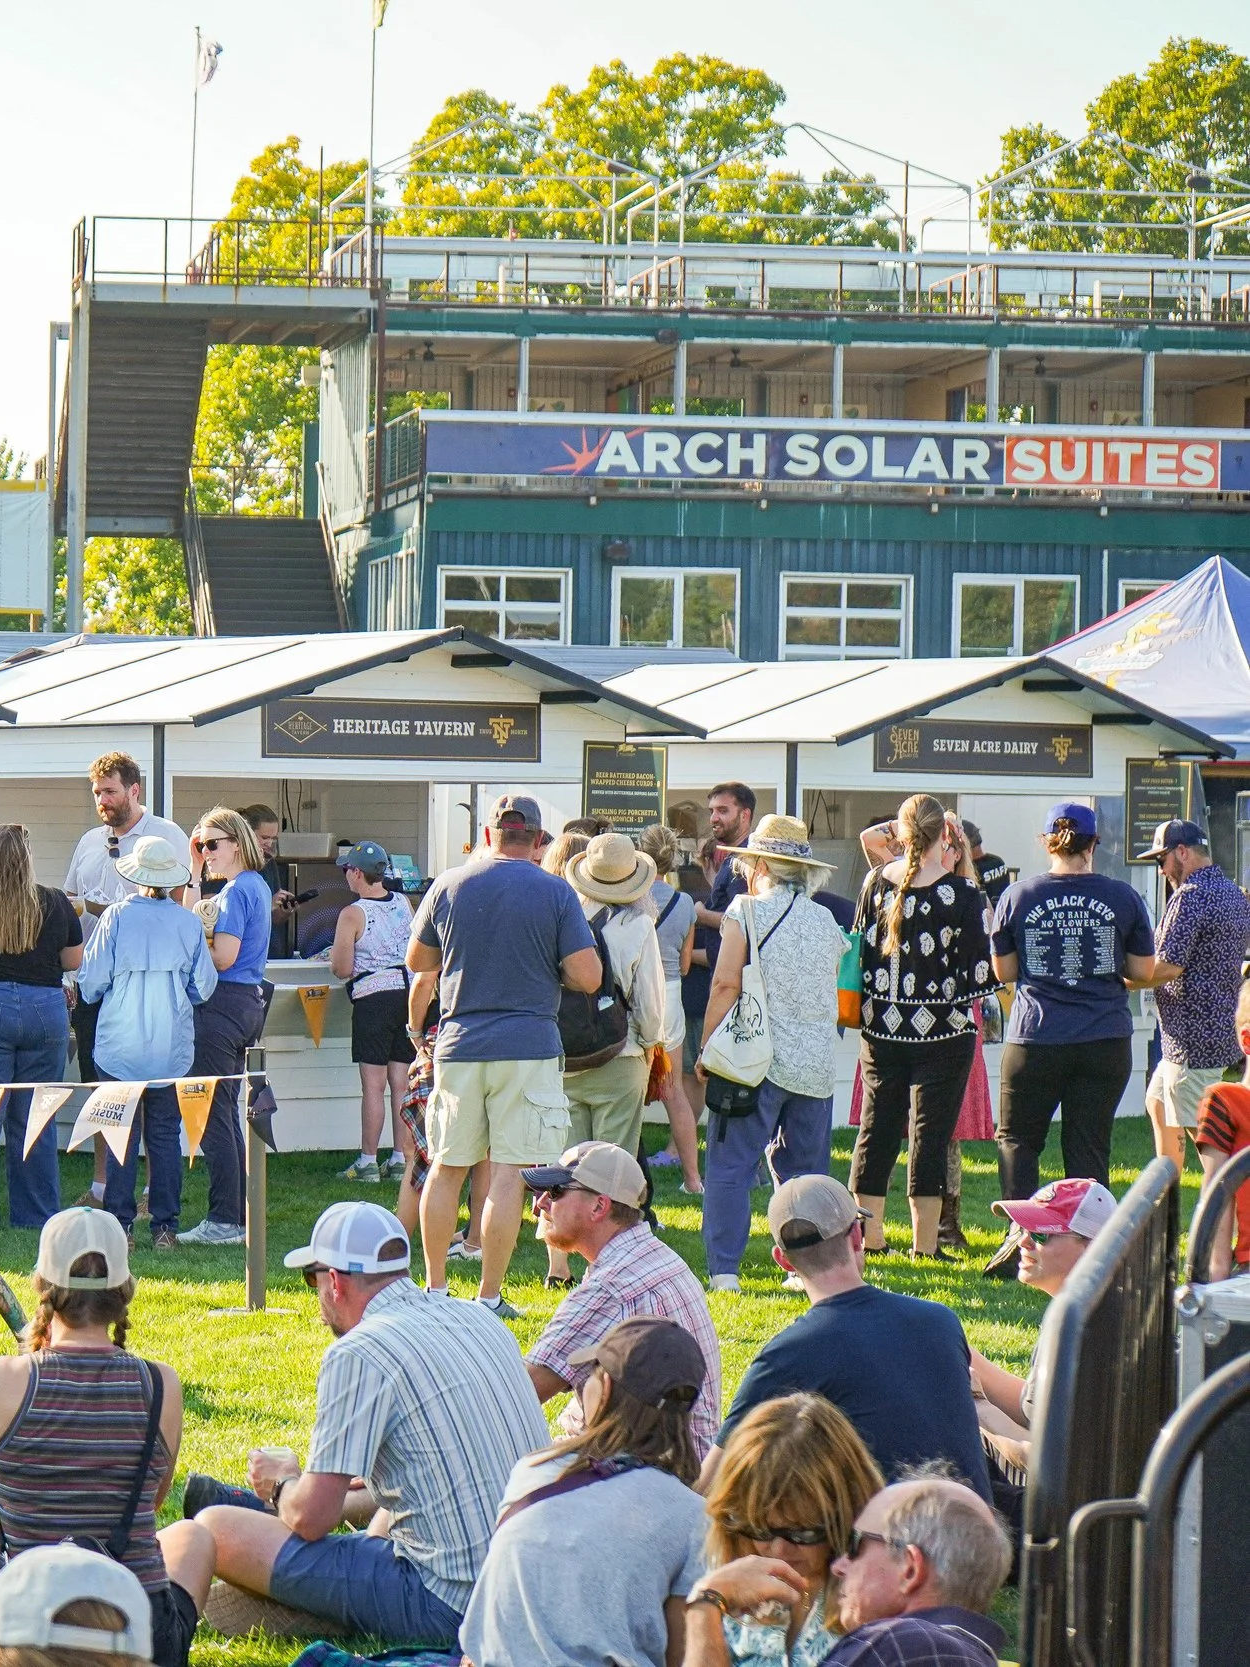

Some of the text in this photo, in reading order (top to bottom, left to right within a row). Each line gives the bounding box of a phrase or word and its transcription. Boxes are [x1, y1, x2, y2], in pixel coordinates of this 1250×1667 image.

[595, 430, 1216, 485] ARCH SOLAR SUITES
[333, 718, 476, 737] HERITAGE TAVERN
[933, 739, 1039, 755] SEVEN ACRE DAIRY
[1025, 895, 1116, 924] THE BLACK KEYS
[1052, 911, 1065, 919] NO
[1041, 918, 1101, 928] NO FLOWERS
[1058, 928, 1084, 936] TOUR
